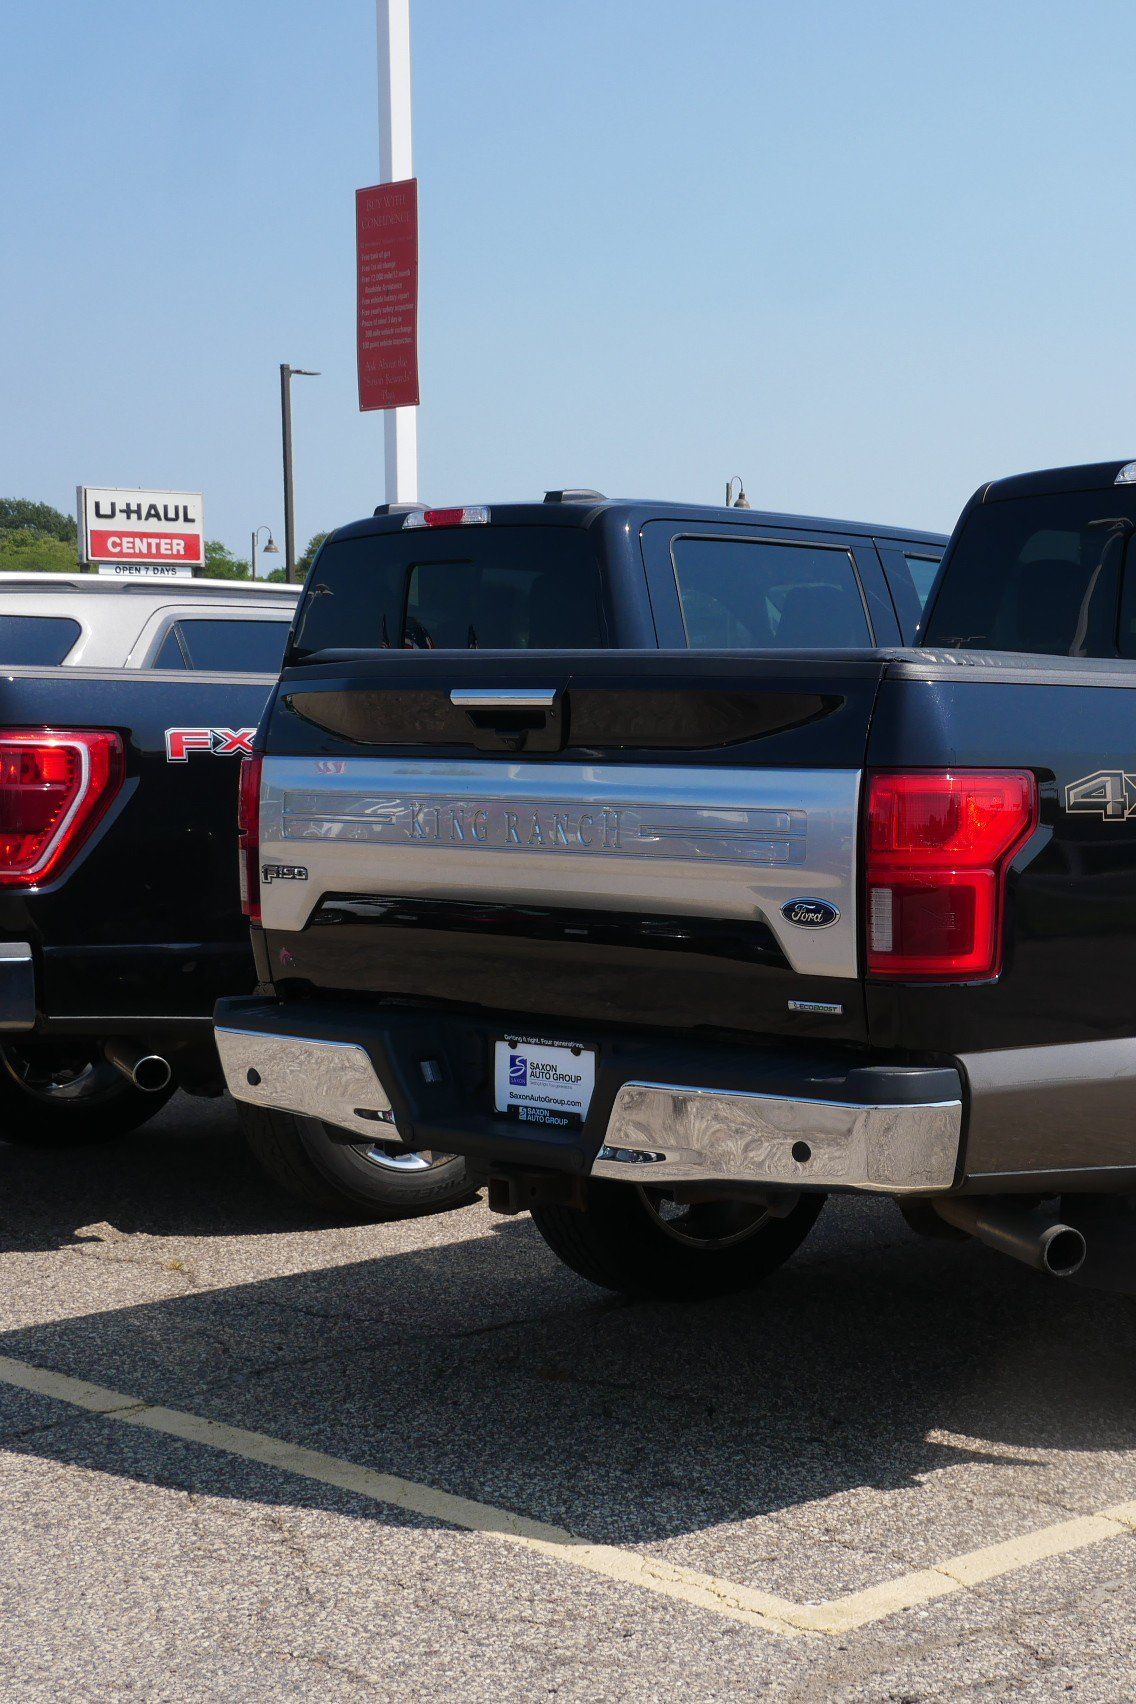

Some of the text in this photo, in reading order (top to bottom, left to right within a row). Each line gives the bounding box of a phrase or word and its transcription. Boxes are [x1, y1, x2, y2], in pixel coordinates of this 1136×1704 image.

[94, 500, 196, 523] U-HAUL
[107, 536, 185, 555] CENTER
[114, 565, 177, 576] OPEN 7 DAYS
[408, 802, 623, 849] KING RANCH
[529, 1061, 558, 1073] SAXON
[529, 1071, 582, 1084] AUTO GROUP
[509, 1091, 582, 1107] SaxonAutoGroup.com
[527, 1107, 550, 1117] SAXON
[527, 1114, 569, 1126] AUTO GROUP
